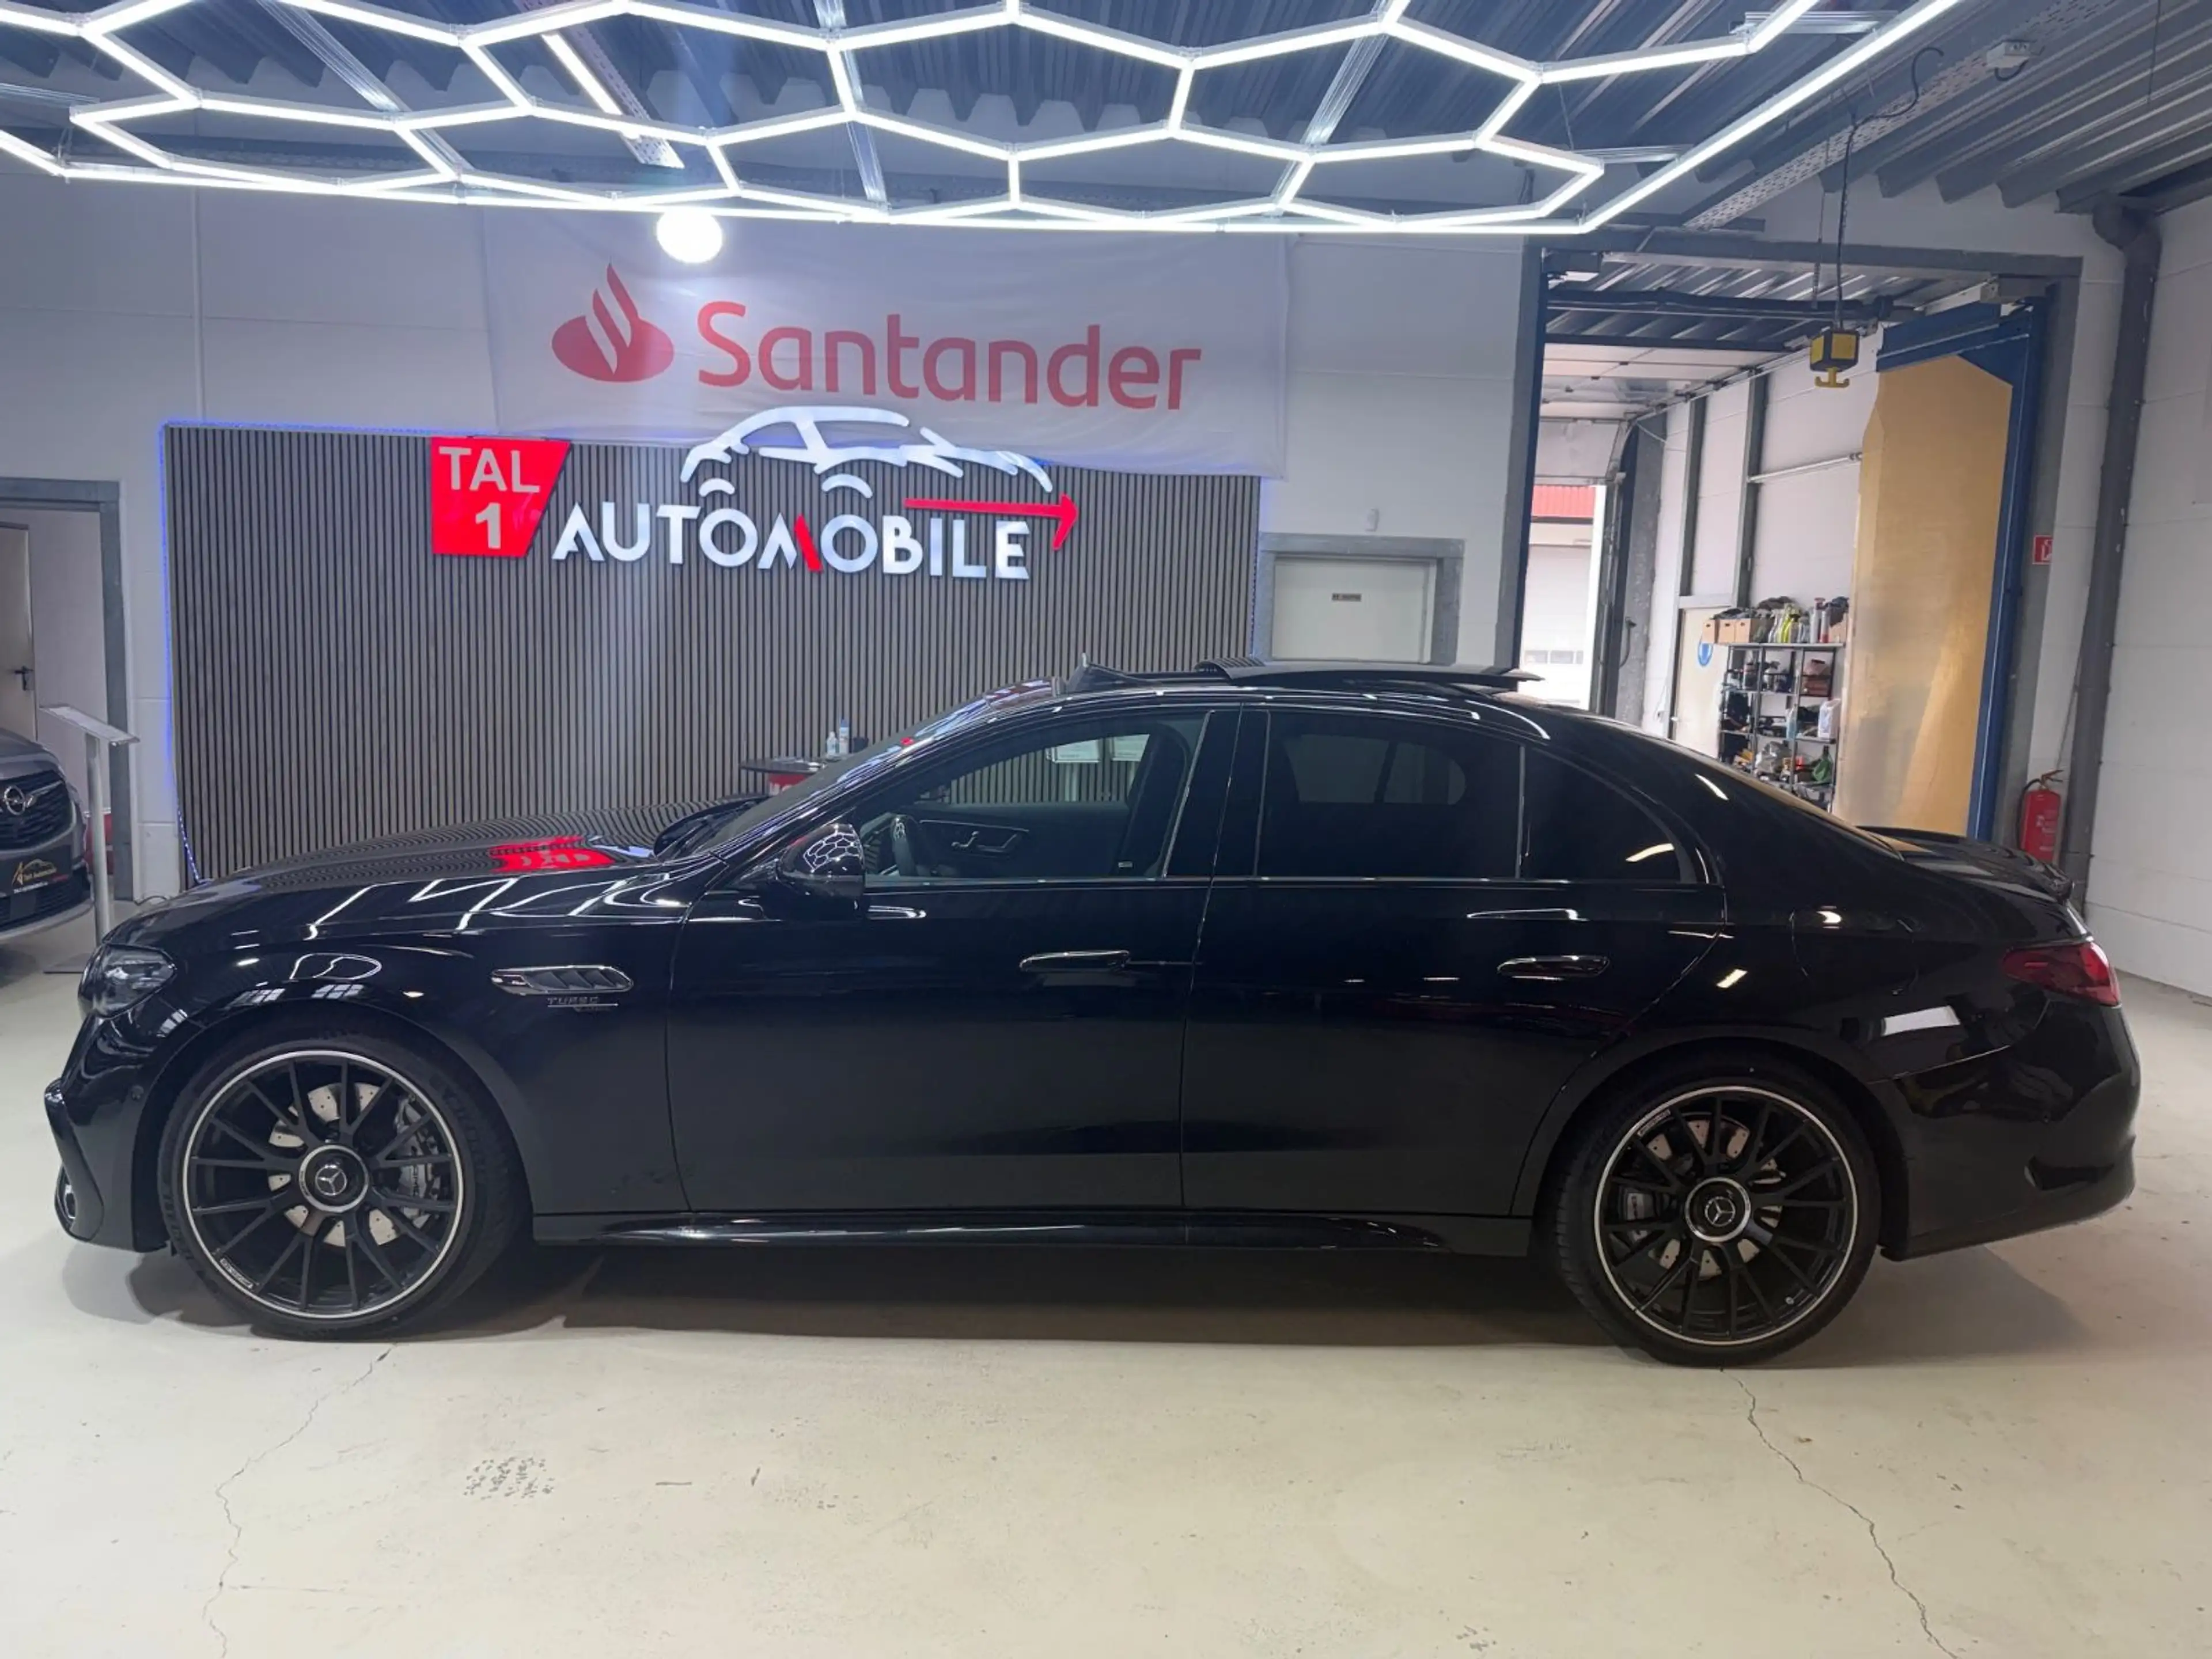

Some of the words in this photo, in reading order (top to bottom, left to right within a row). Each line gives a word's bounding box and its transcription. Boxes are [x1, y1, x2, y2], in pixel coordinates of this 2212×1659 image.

[696, 300, 1202, 411] Santander
[439, 446, 540, 493] TAL
[475, 502, 501, 550] 1
[551, 501, 1031, 579] AUTOMOBILE
